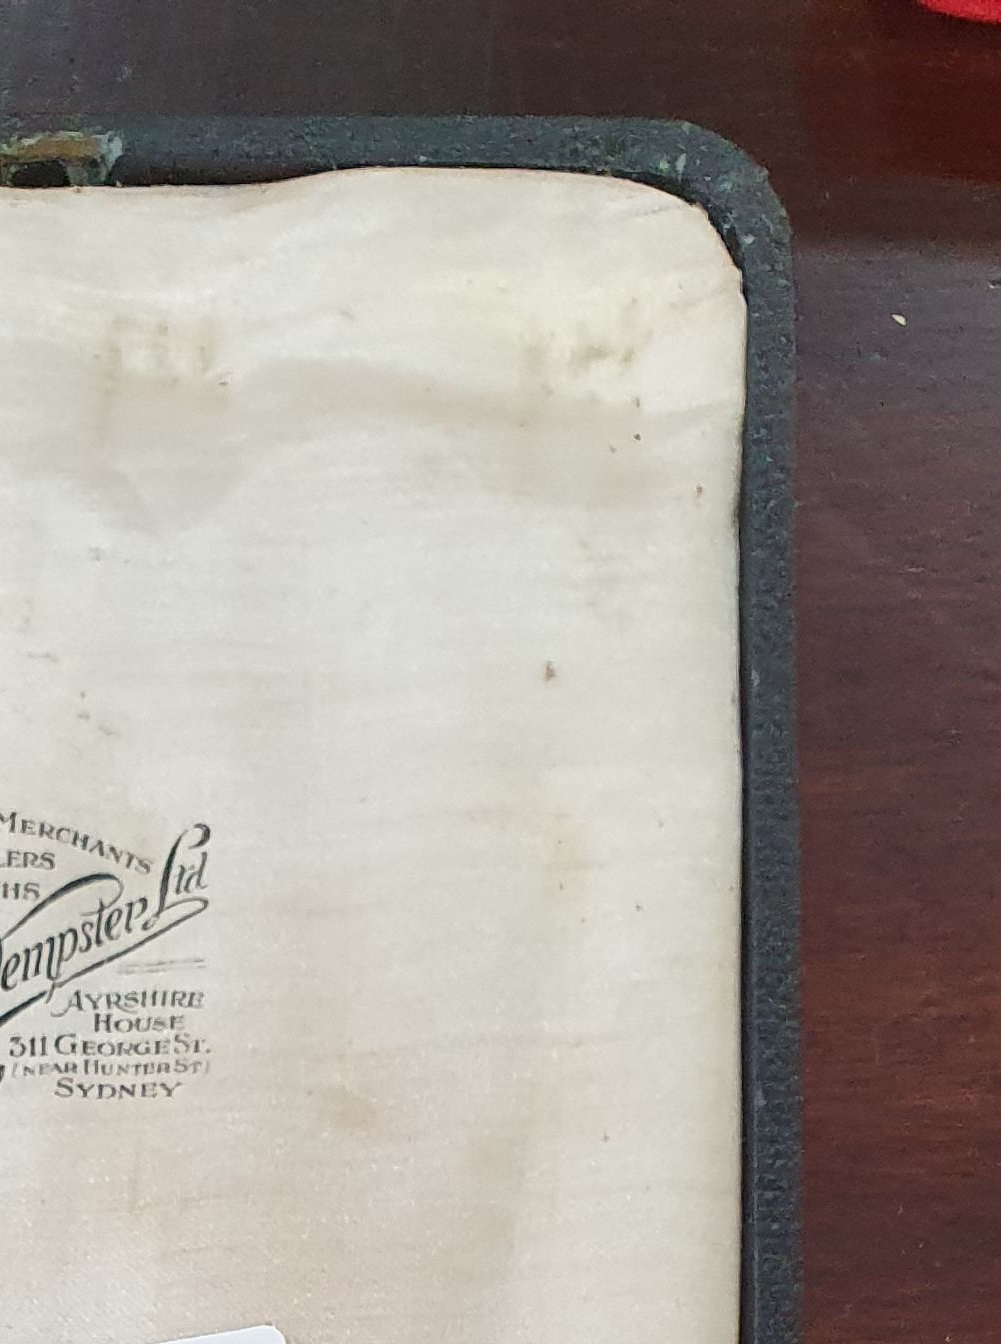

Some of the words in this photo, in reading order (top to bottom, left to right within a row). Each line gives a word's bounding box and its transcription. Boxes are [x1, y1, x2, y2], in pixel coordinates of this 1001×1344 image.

[94, 1013, 186, 1033] HOUSE
[9, 1035, 49, 1057] 311
[54, 1077, 183, 1100] SYDNEY
